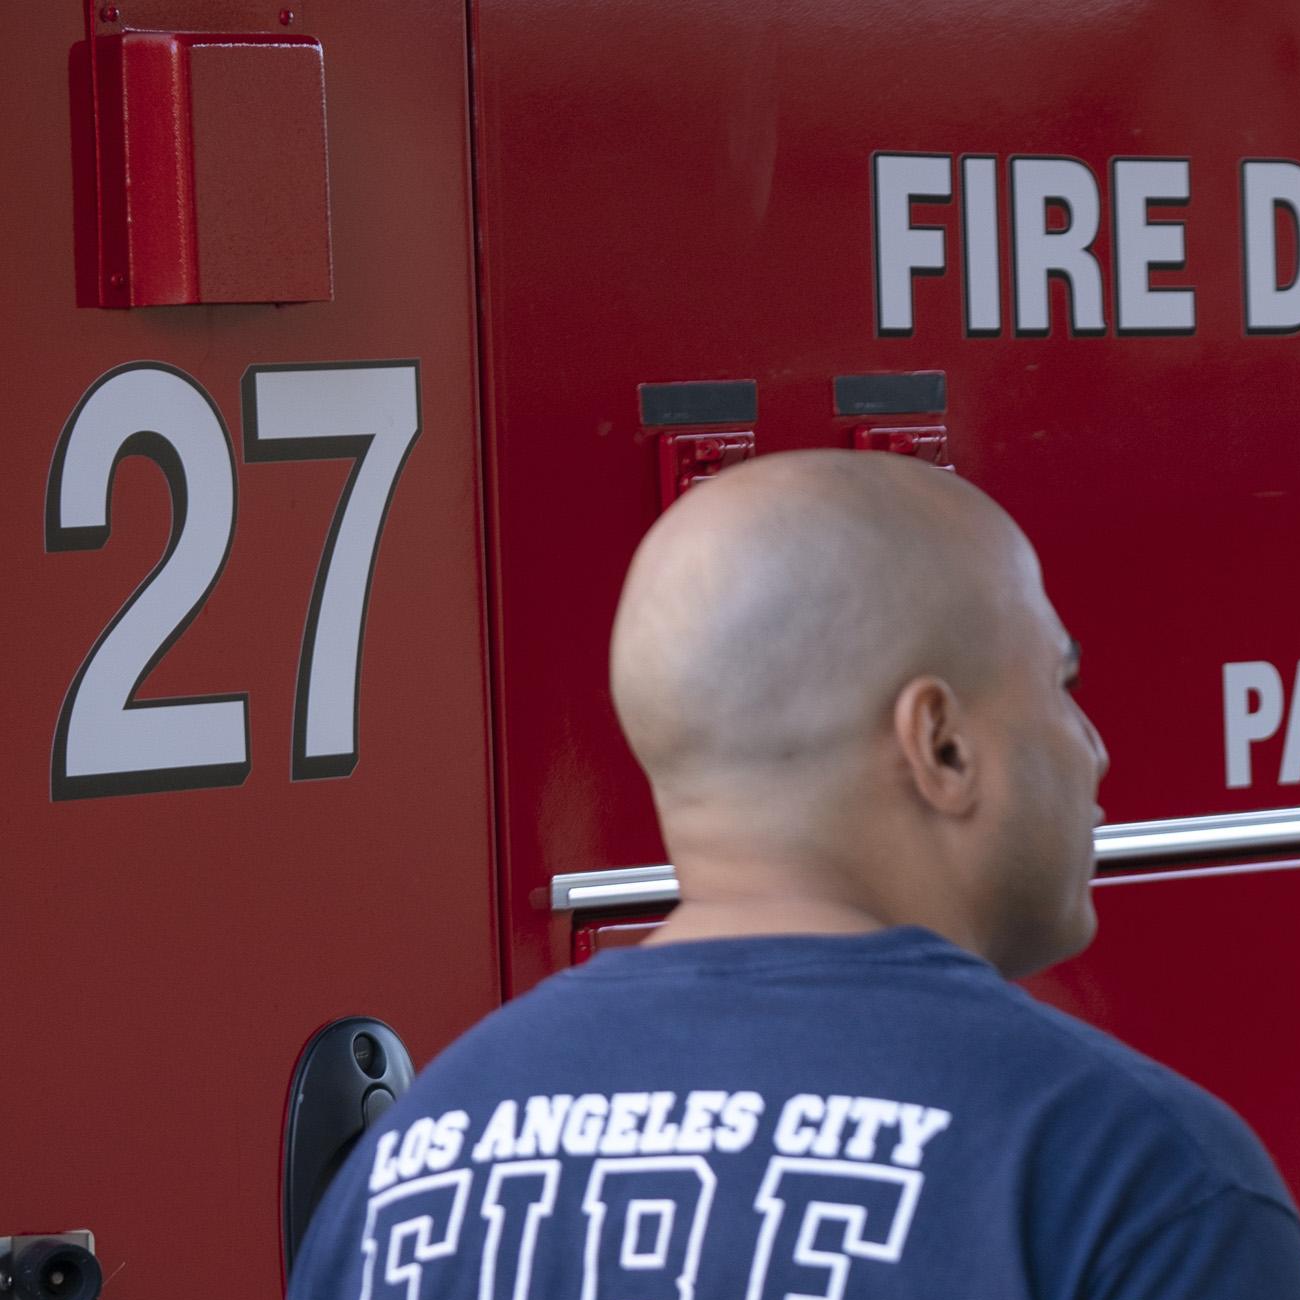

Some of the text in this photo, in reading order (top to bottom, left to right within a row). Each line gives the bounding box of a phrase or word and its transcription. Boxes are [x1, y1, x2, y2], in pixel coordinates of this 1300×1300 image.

[872, 151, 1198, 338] FIRE
[44, 359, 423, 803] 27
[369, 1091, 952, 1194] LOS ANGELES CITY
